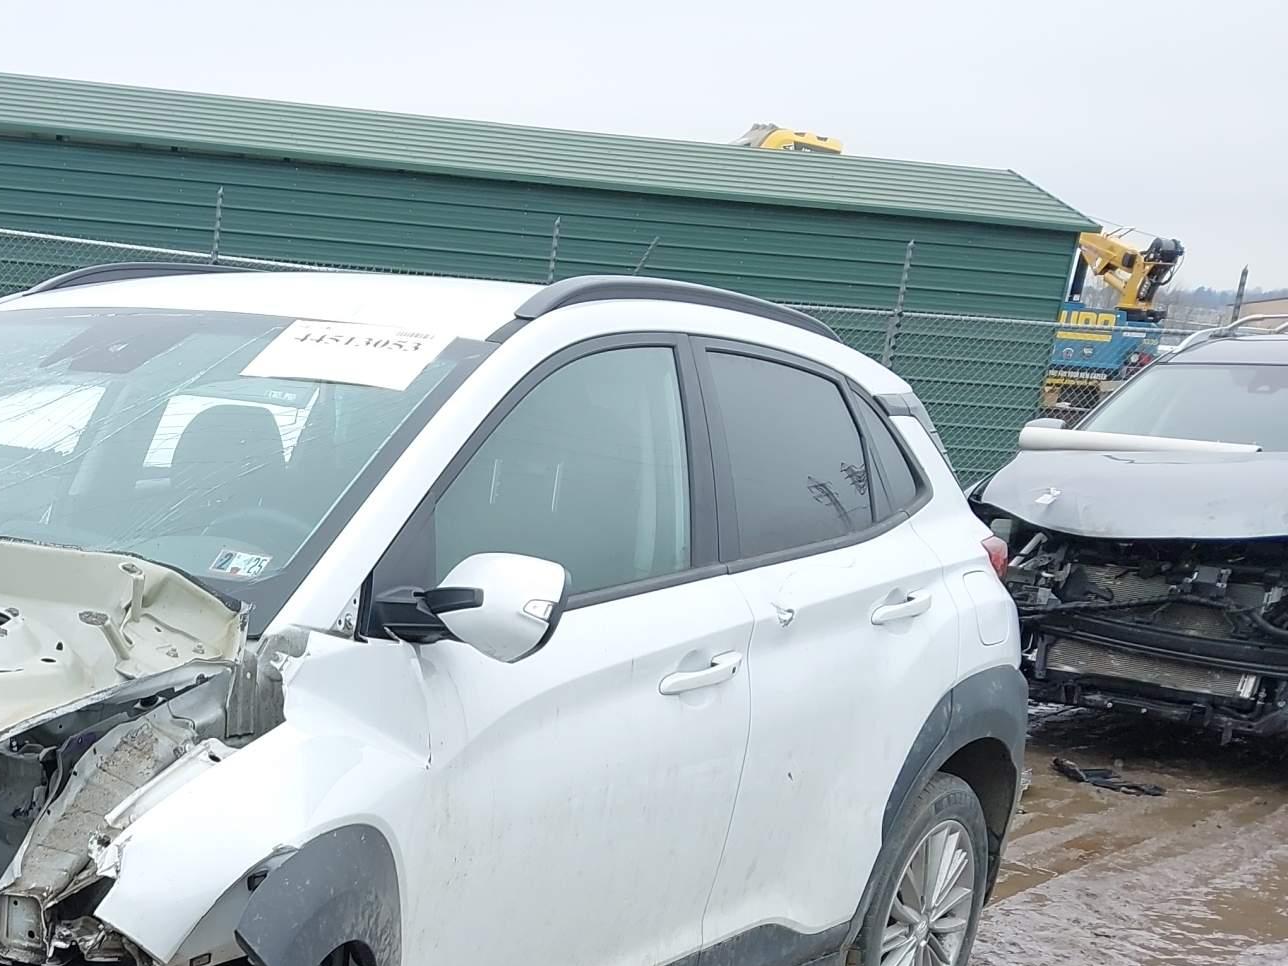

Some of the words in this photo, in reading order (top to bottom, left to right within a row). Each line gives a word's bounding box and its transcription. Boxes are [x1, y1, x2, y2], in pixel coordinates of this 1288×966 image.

[293, 333, 423, 352] 44513053
[216, 552, 233, 570] 2
[246, 557, 268, 575] 25
